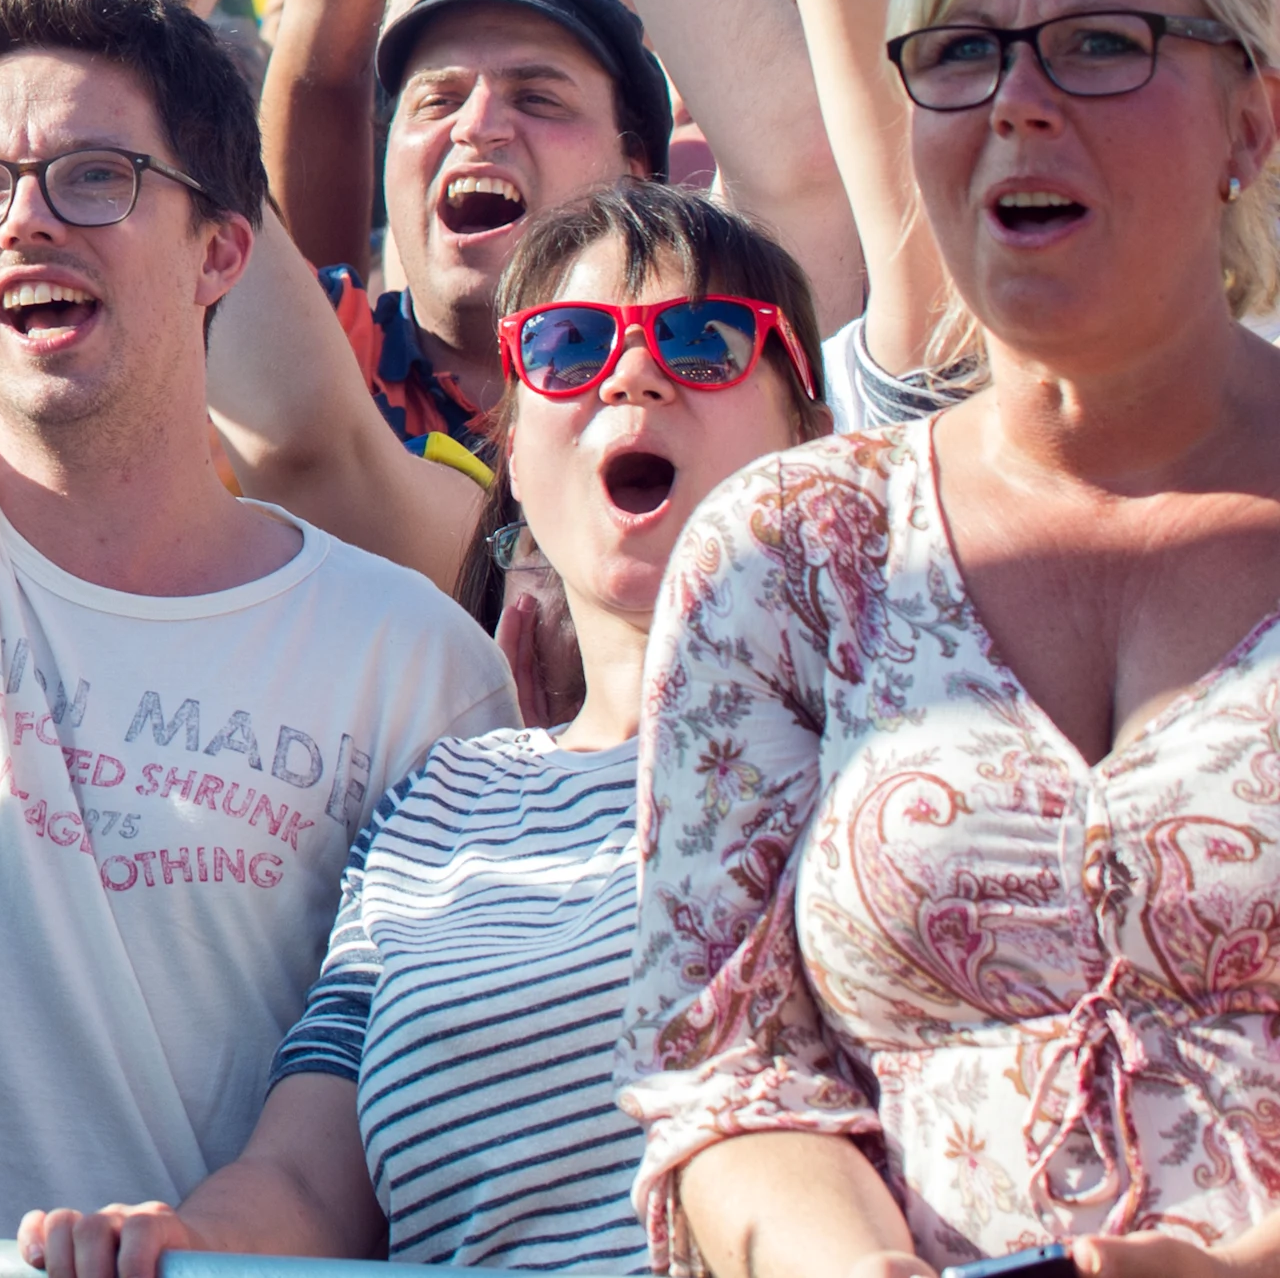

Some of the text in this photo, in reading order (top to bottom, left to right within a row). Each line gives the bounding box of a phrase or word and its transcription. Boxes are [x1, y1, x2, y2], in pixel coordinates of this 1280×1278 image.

[124, 690, 372, 826] MADE
[81, 805, 142, 839] 975
[135, 762, 315, 851] SHRUNK
[100, 846, 284, 893] OTHING
